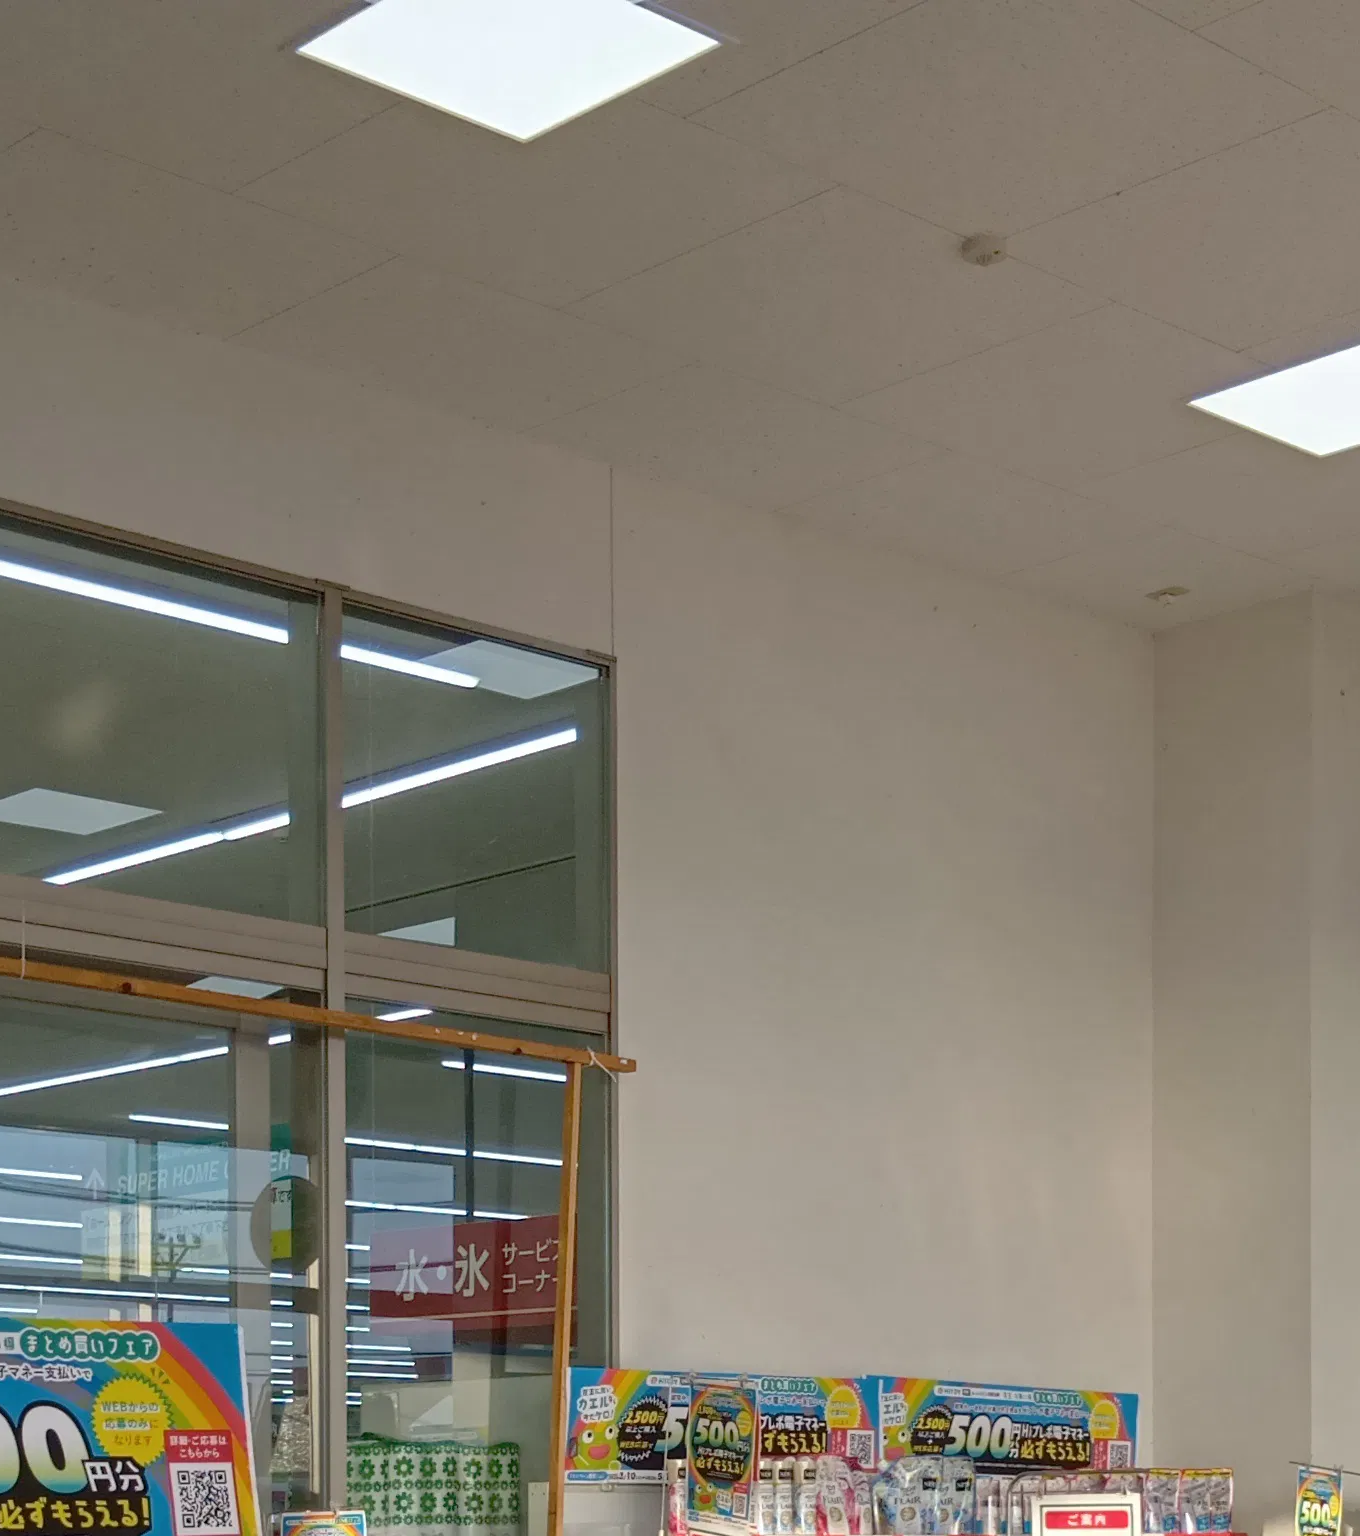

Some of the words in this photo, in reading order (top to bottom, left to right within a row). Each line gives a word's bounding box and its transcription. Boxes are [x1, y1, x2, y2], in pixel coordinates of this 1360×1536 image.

[395, 1242, 491, 1302] 水・氷
[502, 1270, 560, 1294] コーナ
[24, 1333, 155, 1356] まとめ買いフェア
[100, 1401, 160, 1413] WEBからの
[103, 1418, 159, 1431] 応募のみに
[114, 1435, 153, 1447] なります
[179, 1448, 220, 1459] こちらから
[1067, 1513, 1107, 1526] ご案内
